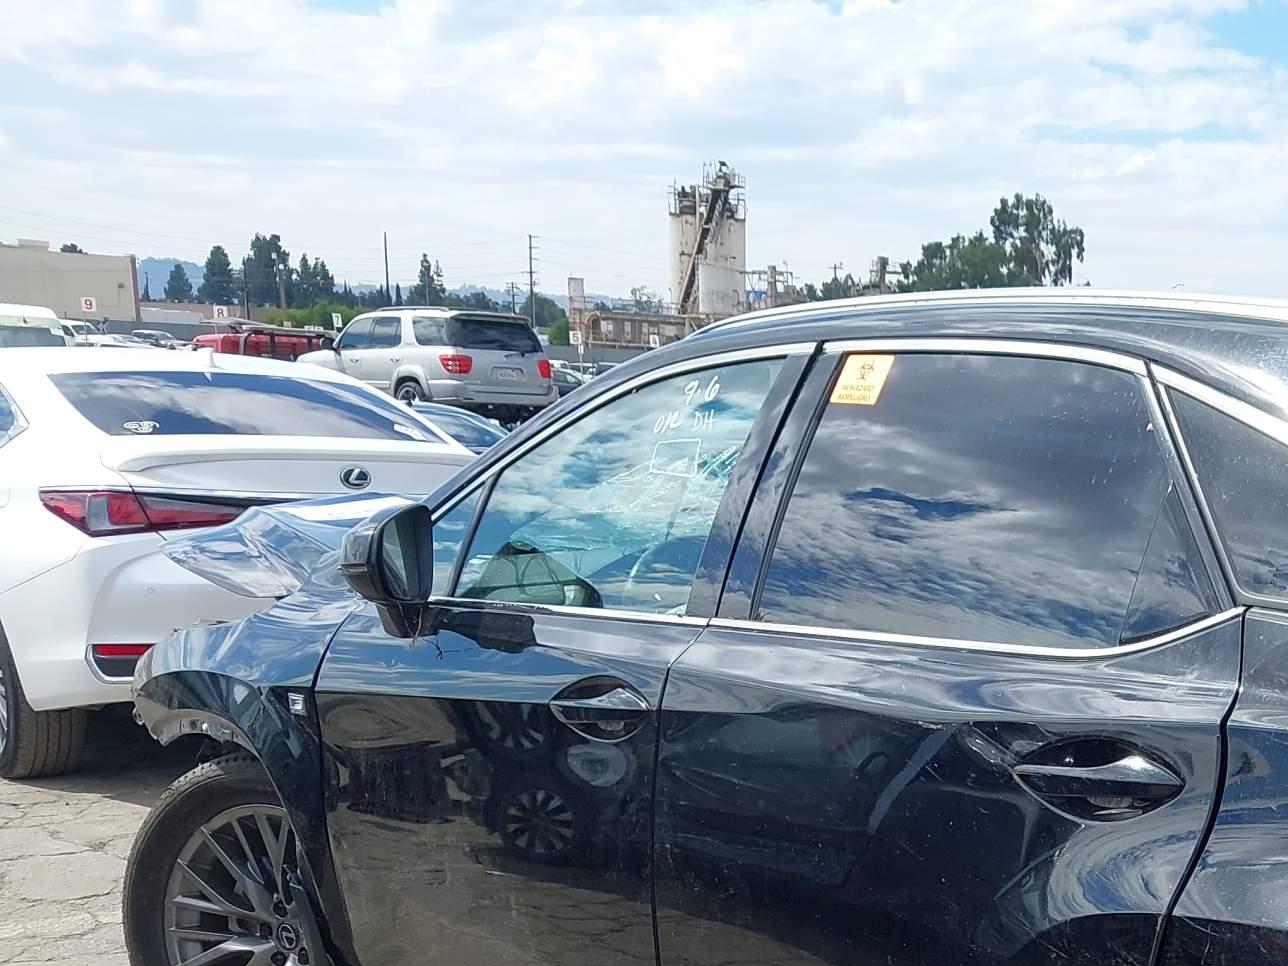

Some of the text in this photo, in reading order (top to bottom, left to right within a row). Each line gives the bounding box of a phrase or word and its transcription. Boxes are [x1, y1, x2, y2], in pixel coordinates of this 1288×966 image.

[84, 299, 93, 311] 9
[216, 307, 225, 318] 8
[572, 332, 580, 343] 5
